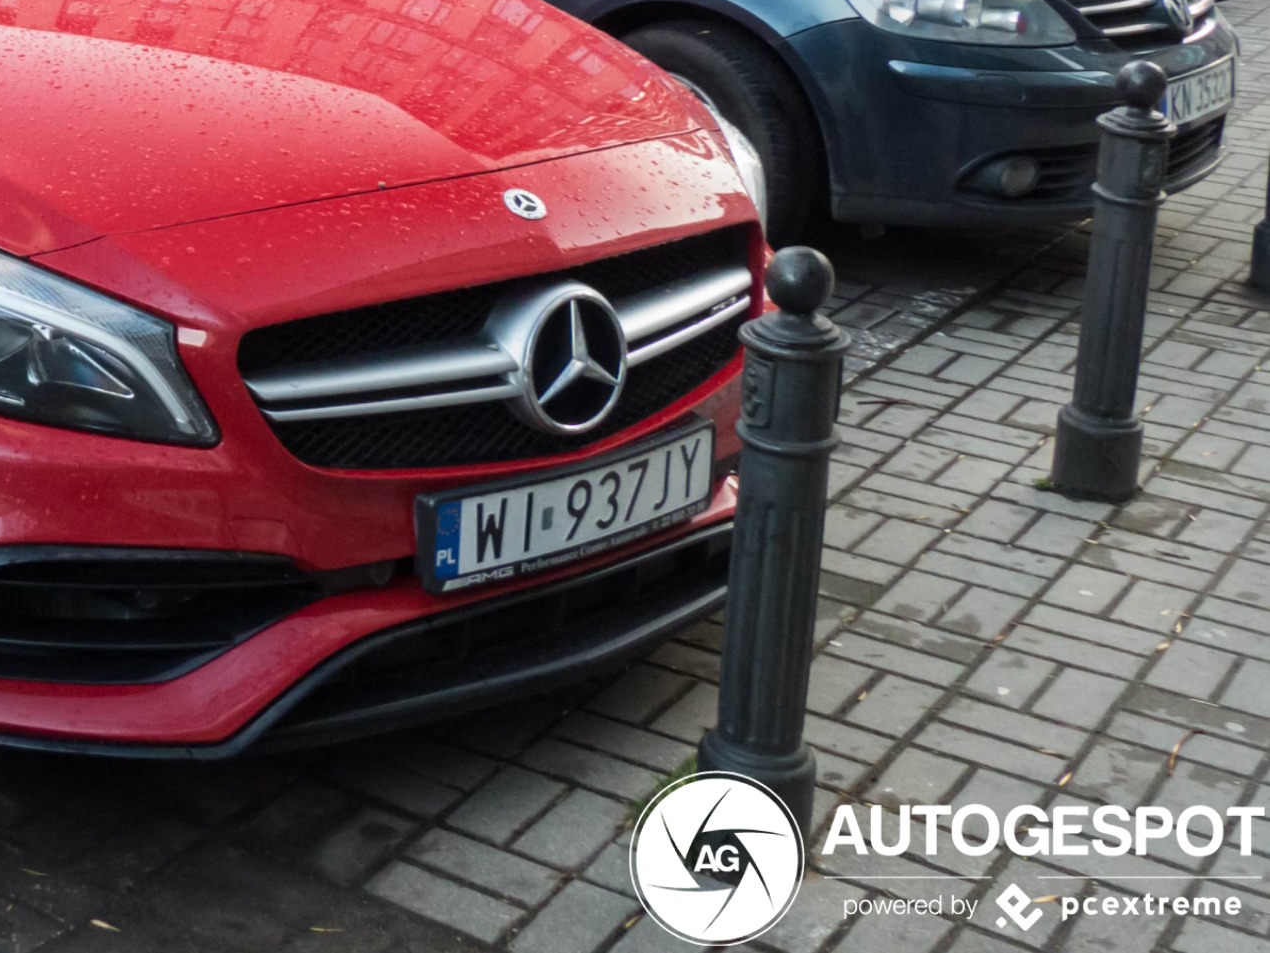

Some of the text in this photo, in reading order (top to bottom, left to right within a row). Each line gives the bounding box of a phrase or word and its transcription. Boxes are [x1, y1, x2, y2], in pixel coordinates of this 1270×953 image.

[1171, 81, 1192, 122] KN
[476, 437, 701, 564] WI 937JY
[436, 548, 456, 567] PL
[458, 566, 514, 586] AMG
